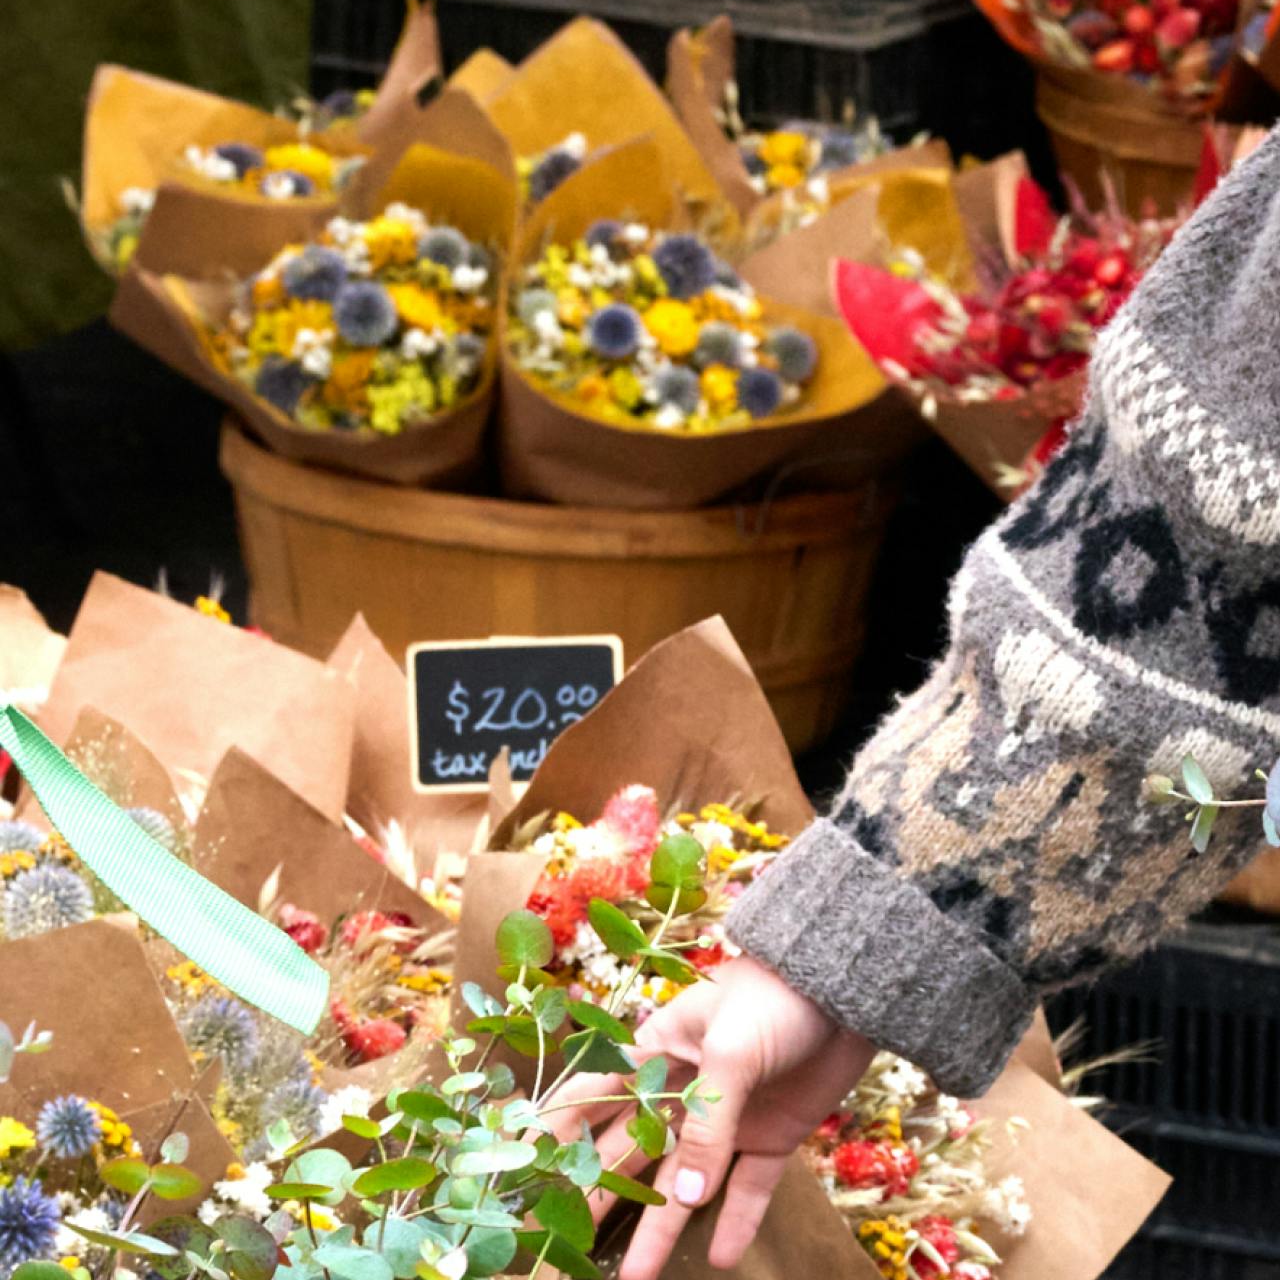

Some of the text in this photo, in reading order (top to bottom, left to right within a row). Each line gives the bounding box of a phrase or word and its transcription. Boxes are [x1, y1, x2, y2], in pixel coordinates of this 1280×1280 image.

[444, 679, 599, 735] $20.00
[432, 738, 549, 778] tax ncl
